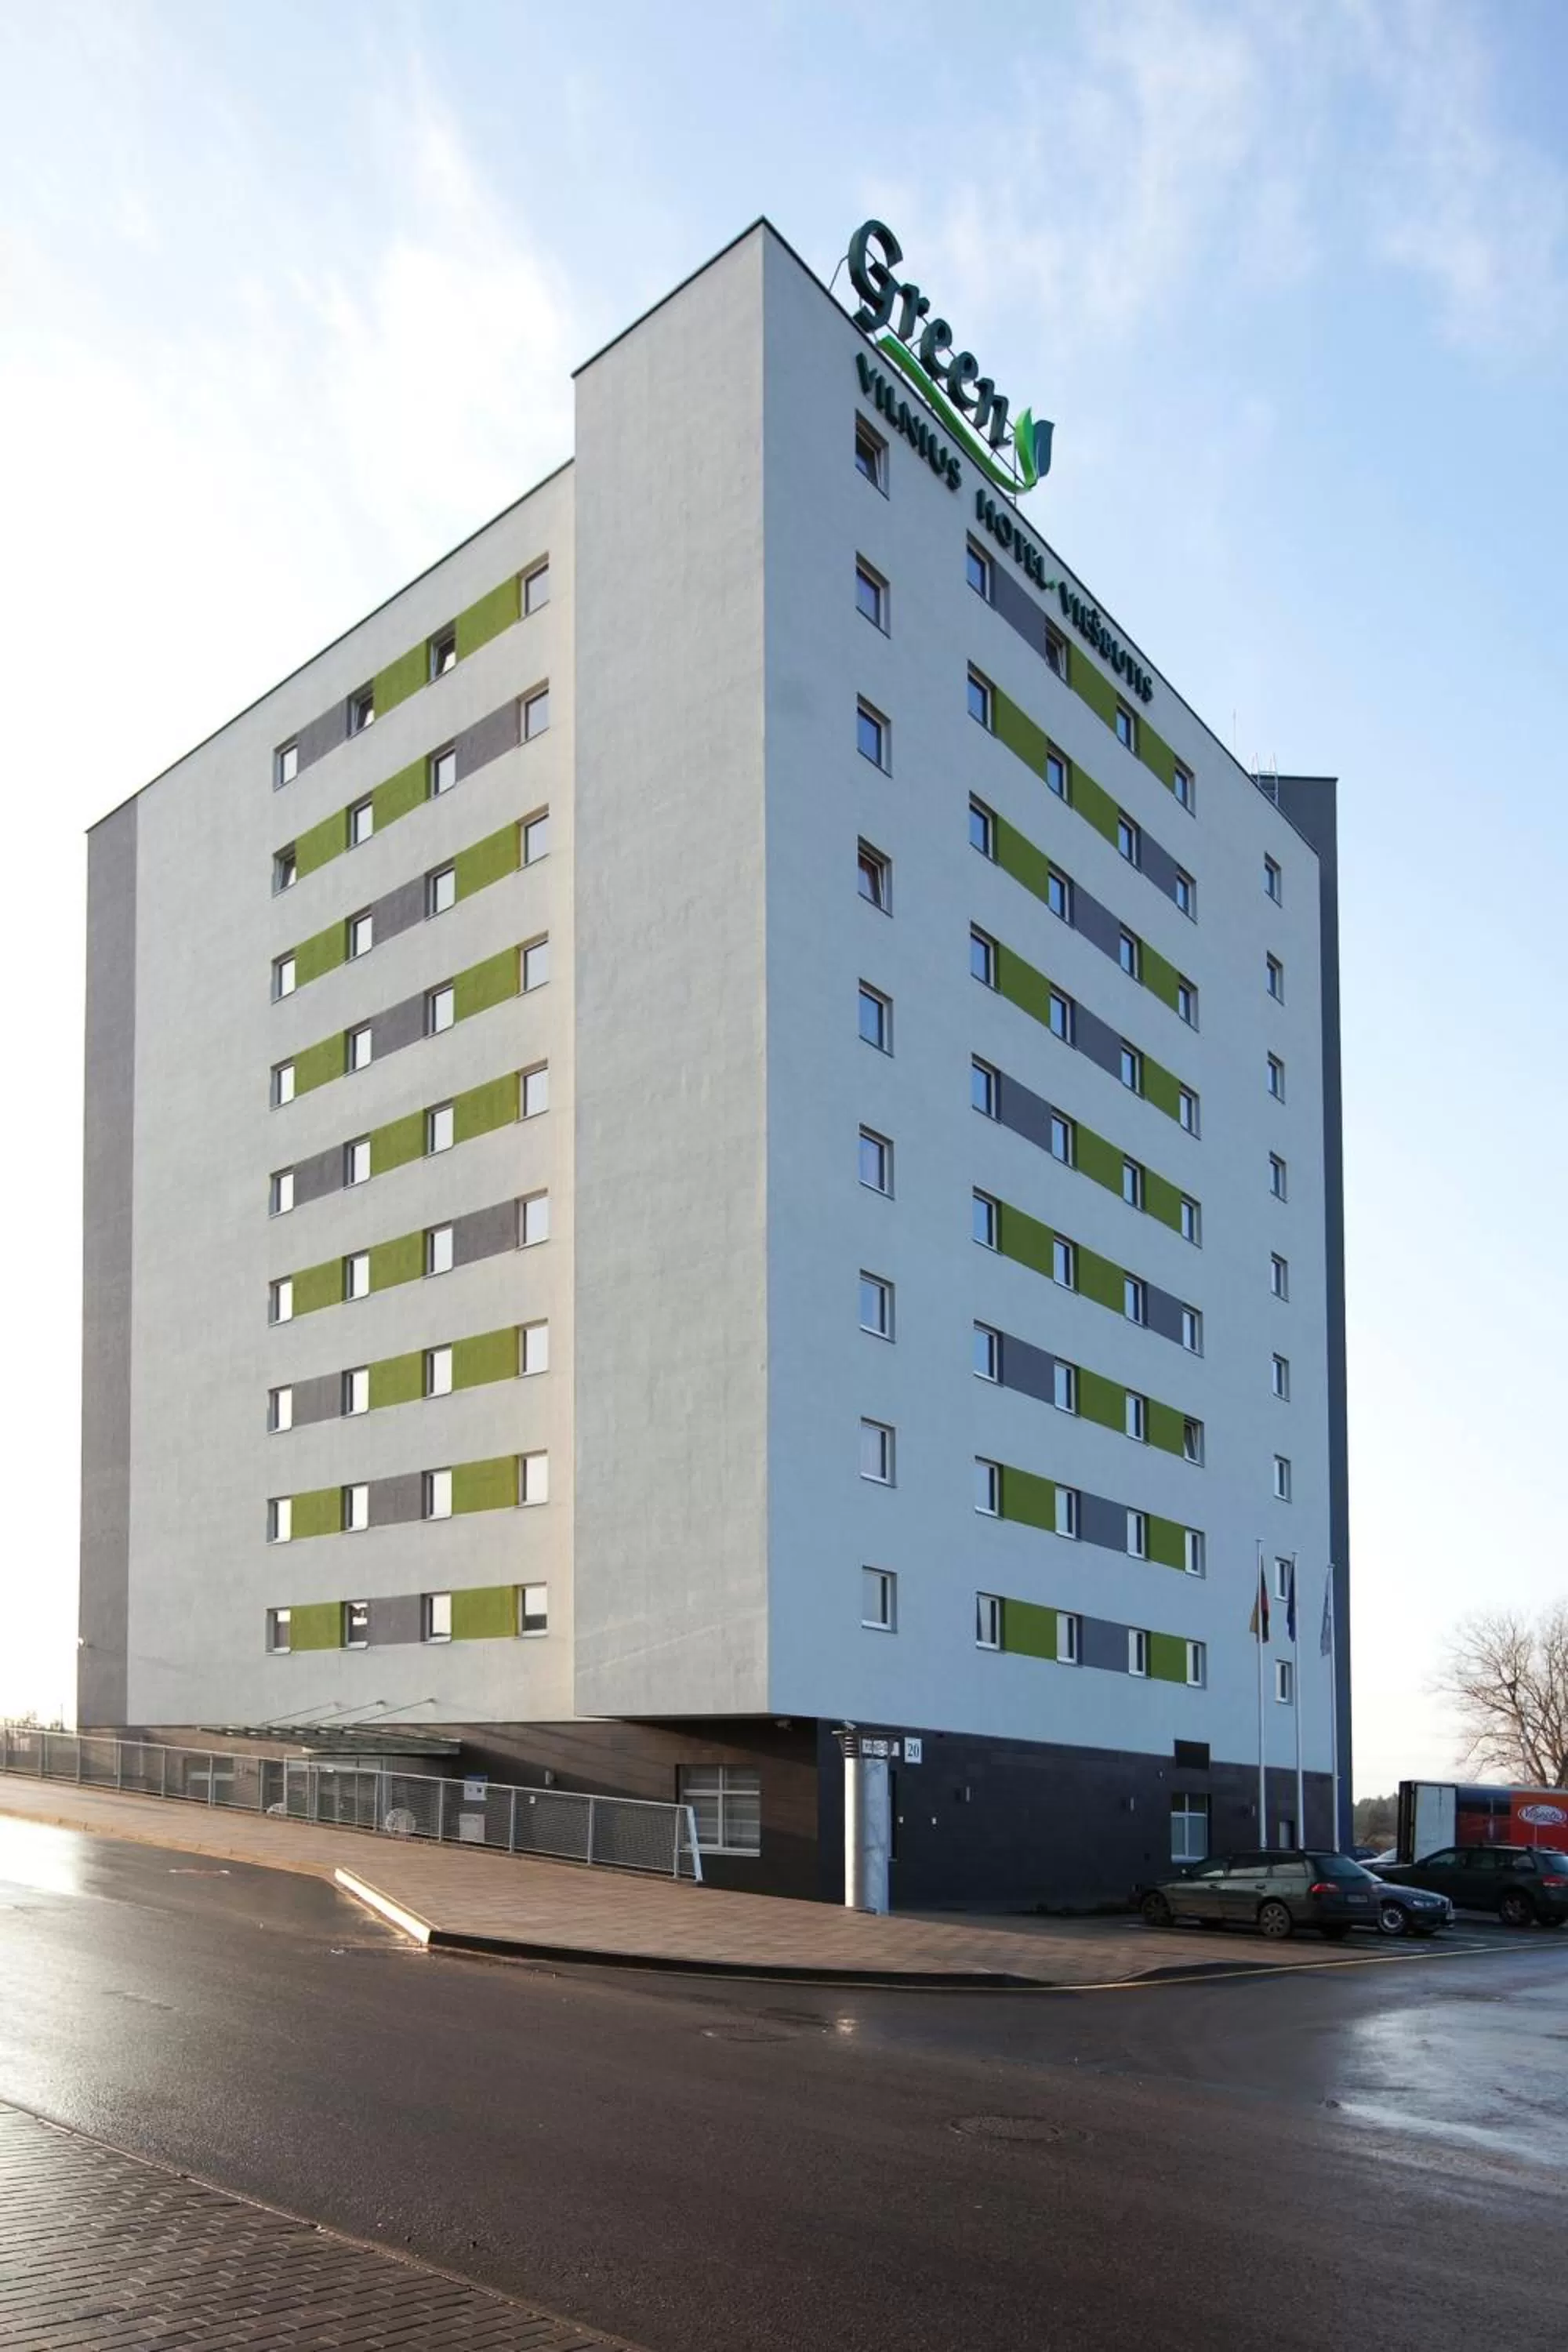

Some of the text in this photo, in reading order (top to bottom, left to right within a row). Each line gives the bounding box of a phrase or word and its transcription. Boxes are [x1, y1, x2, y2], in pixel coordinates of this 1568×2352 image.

[848, 219, 1011, 448] Green
[855, 351, 961, 491] VILNIUS
[975, 488, 1047, 590] HOTEL
[908, 1743, 920, 1757] 20
